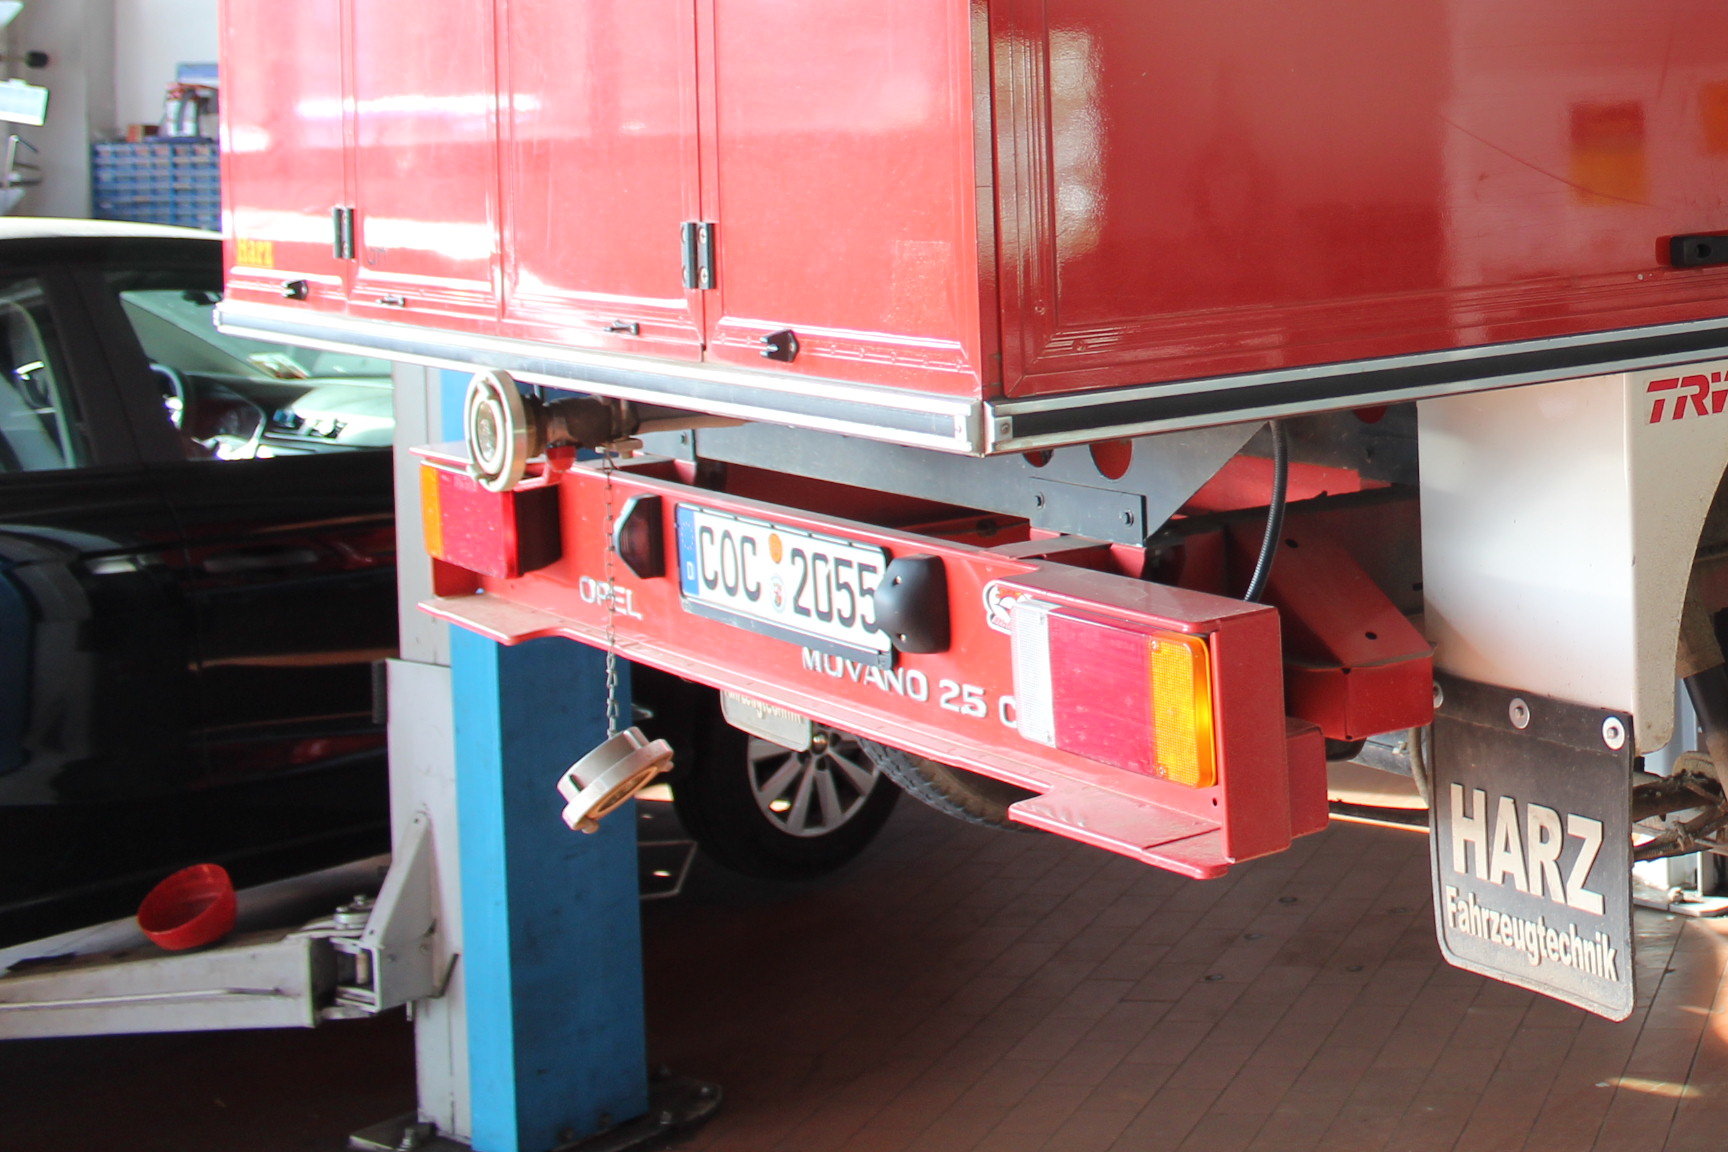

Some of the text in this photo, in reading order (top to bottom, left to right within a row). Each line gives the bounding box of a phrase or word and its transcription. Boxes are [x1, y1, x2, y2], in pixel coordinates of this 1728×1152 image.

[579, 576, 643, 621] OPEL
[687, 561, 695, 581] D
[699, 525, 880, 635] COC 2055
[802, 646, 929, 702] MOVANO
[1450, 782, 1606, 916] HARZ
[1445, 885, 1619, 982] Fahrzeugtechnik
